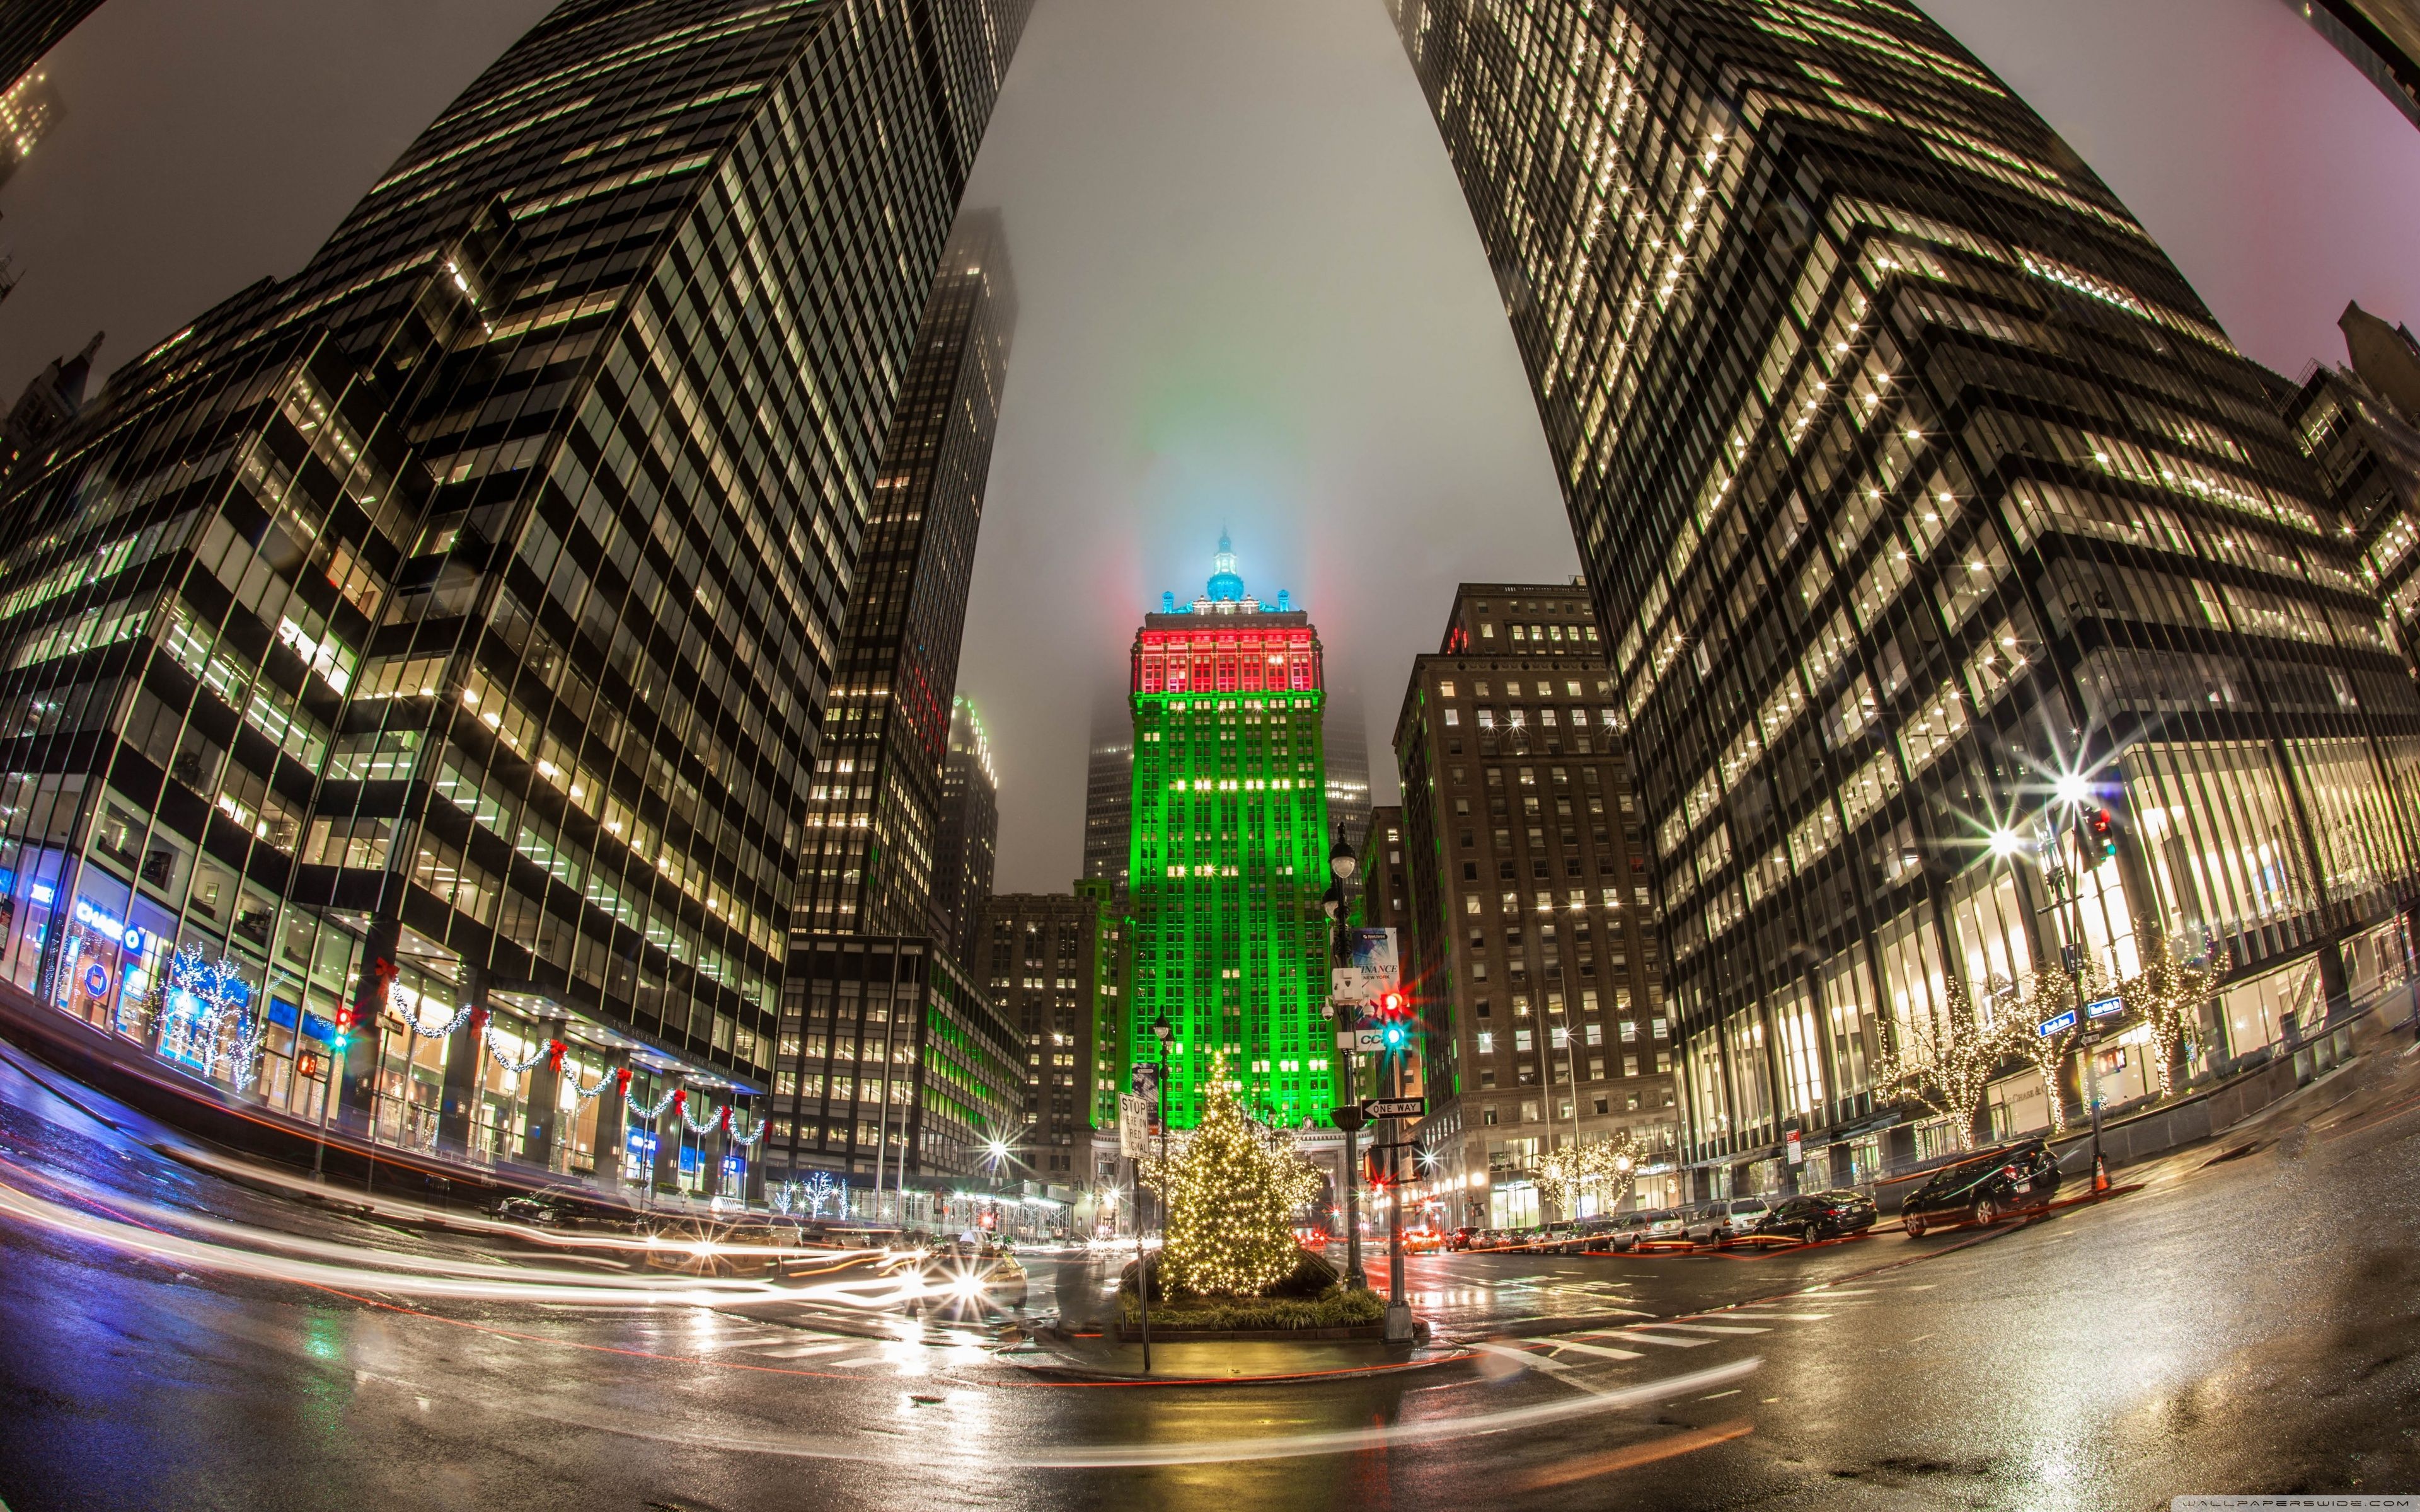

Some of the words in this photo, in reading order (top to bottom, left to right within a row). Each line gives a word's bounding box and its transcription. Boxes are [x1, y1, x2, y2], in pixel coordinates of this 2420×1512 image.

[1356, 965, 1397, 973] INANCE
[613, 1019, 628, 1031] TWO
[631, 1028, 662, 1047] SEVENTY
[666, 1045, 686, 1058] SEVEN
[689, 1054, 704, 1066] PARK
[707, 1063, 729, 1076] AVENUE
[2012, 1090, 2034, 1103] CHASE
[2035, 1086, 2041, 1096] &
[1122, 1097, 1146, 1114] STOP
[1373, 1105, 1392, 1113] ONE
[1397, 1104, 1416, 1112] WAY
[1123, 1114, 1137, 1126] HERE
[1139, 1119, 1146, 1128] ON
[1130, 1128, 1141, 1139] RED
[1124, 1141, 1148, 1154] SIGNAL
